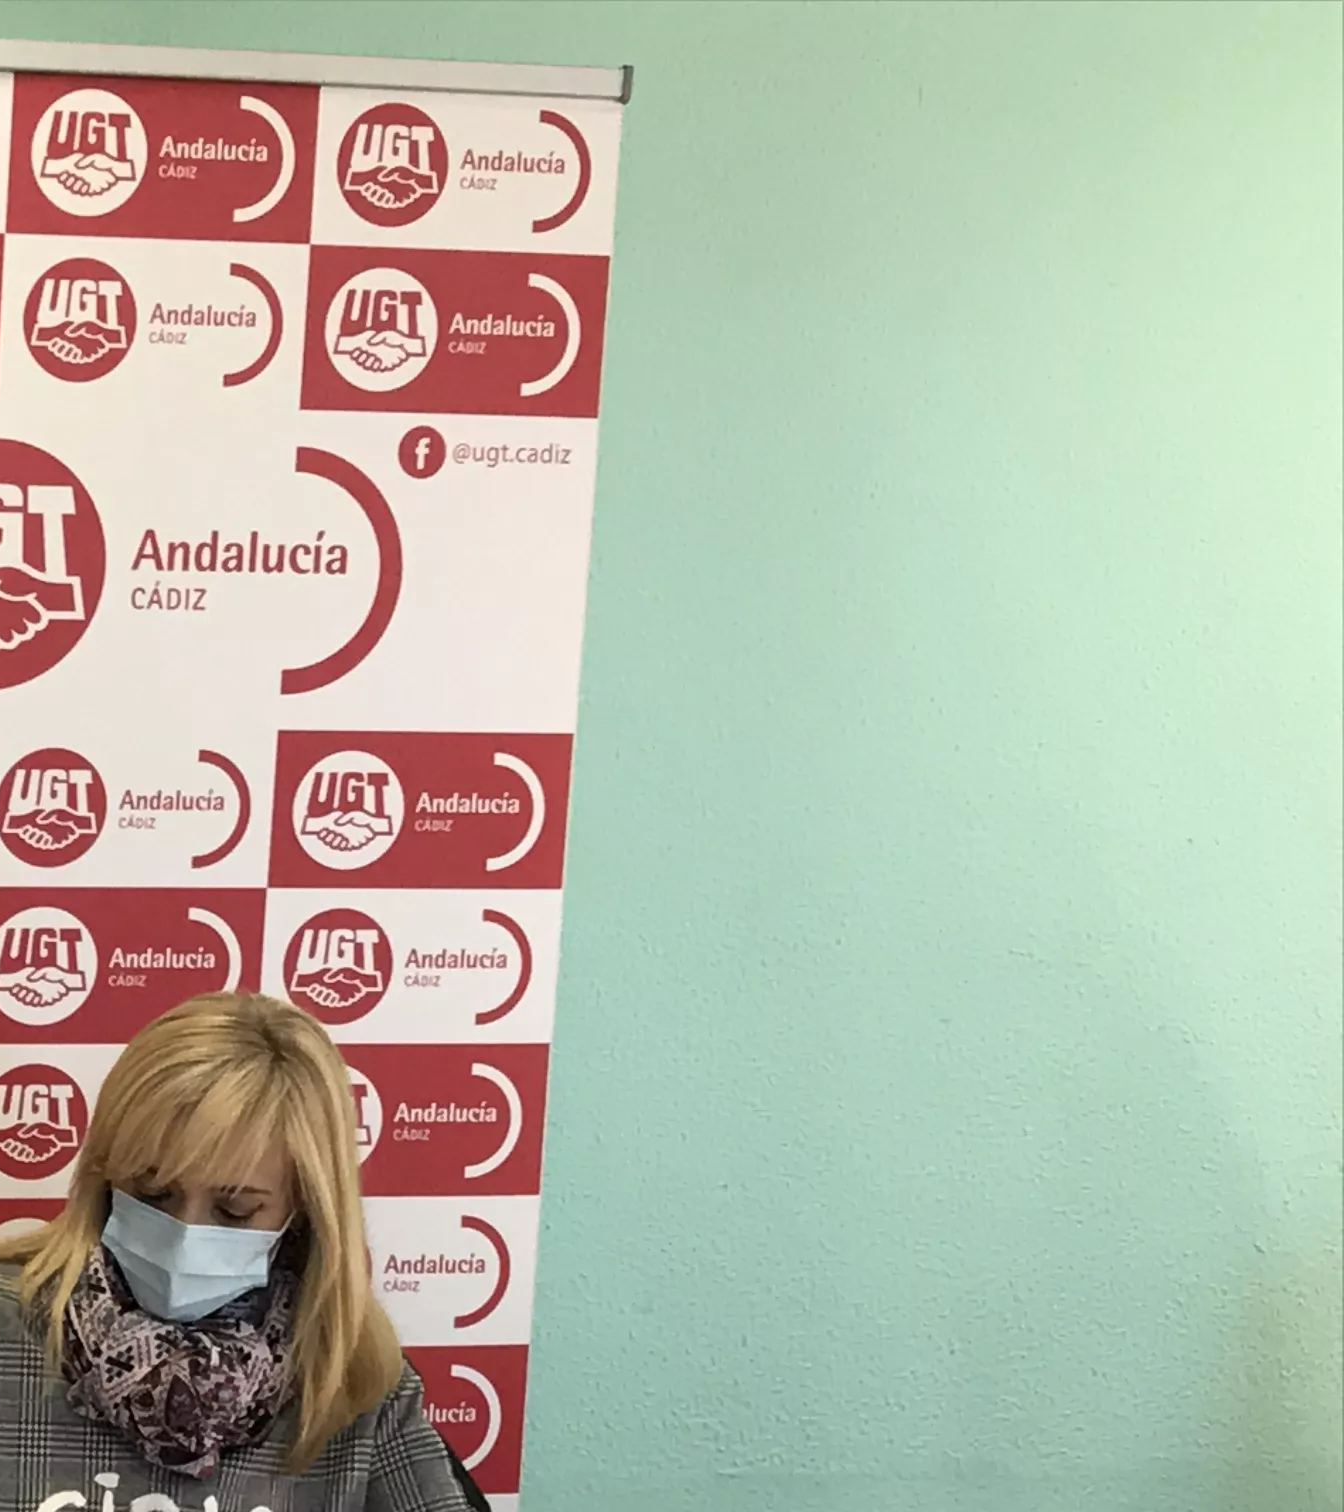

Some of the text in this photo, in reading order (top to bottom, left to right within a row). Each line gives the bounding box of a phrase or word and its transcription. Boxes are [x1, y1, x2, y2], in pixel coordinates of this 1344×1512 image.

[46, 111, 131, 160] UGT
[353, 124, 434, 174] UGT
[160, 136, 267, 165] Andalucía
[461, 149, 565, 174] Andalucía
[39, 278, 123, 328] UGT
[150, 303, 256, 327] Andalucía
[341, 289, 422, 341] UGT
[449, 313, 554, 337] Andalucía
[453, 443, 571, 468] @ugt.cadiz
[132, 529, 347, 574] Andalucía
[131, 581, 206, 610] CÁDIZ
[15, 770, 92, 818] UGT
[120, 790, 224, 810] Andalucía
[307, 774, 388, 821] UGT
[416, 792, 519, 813] Andalucía
[1, 929, 84, 977] UGT
[109, 947, 215, 968] Andalucía
[298, 931, 376, 977] UGT
[405, 948, 507, 969] Andalucía
[394, 1102, 496, 1122] Andalucía
[384, 1254, 485, 1274] Andalucía
